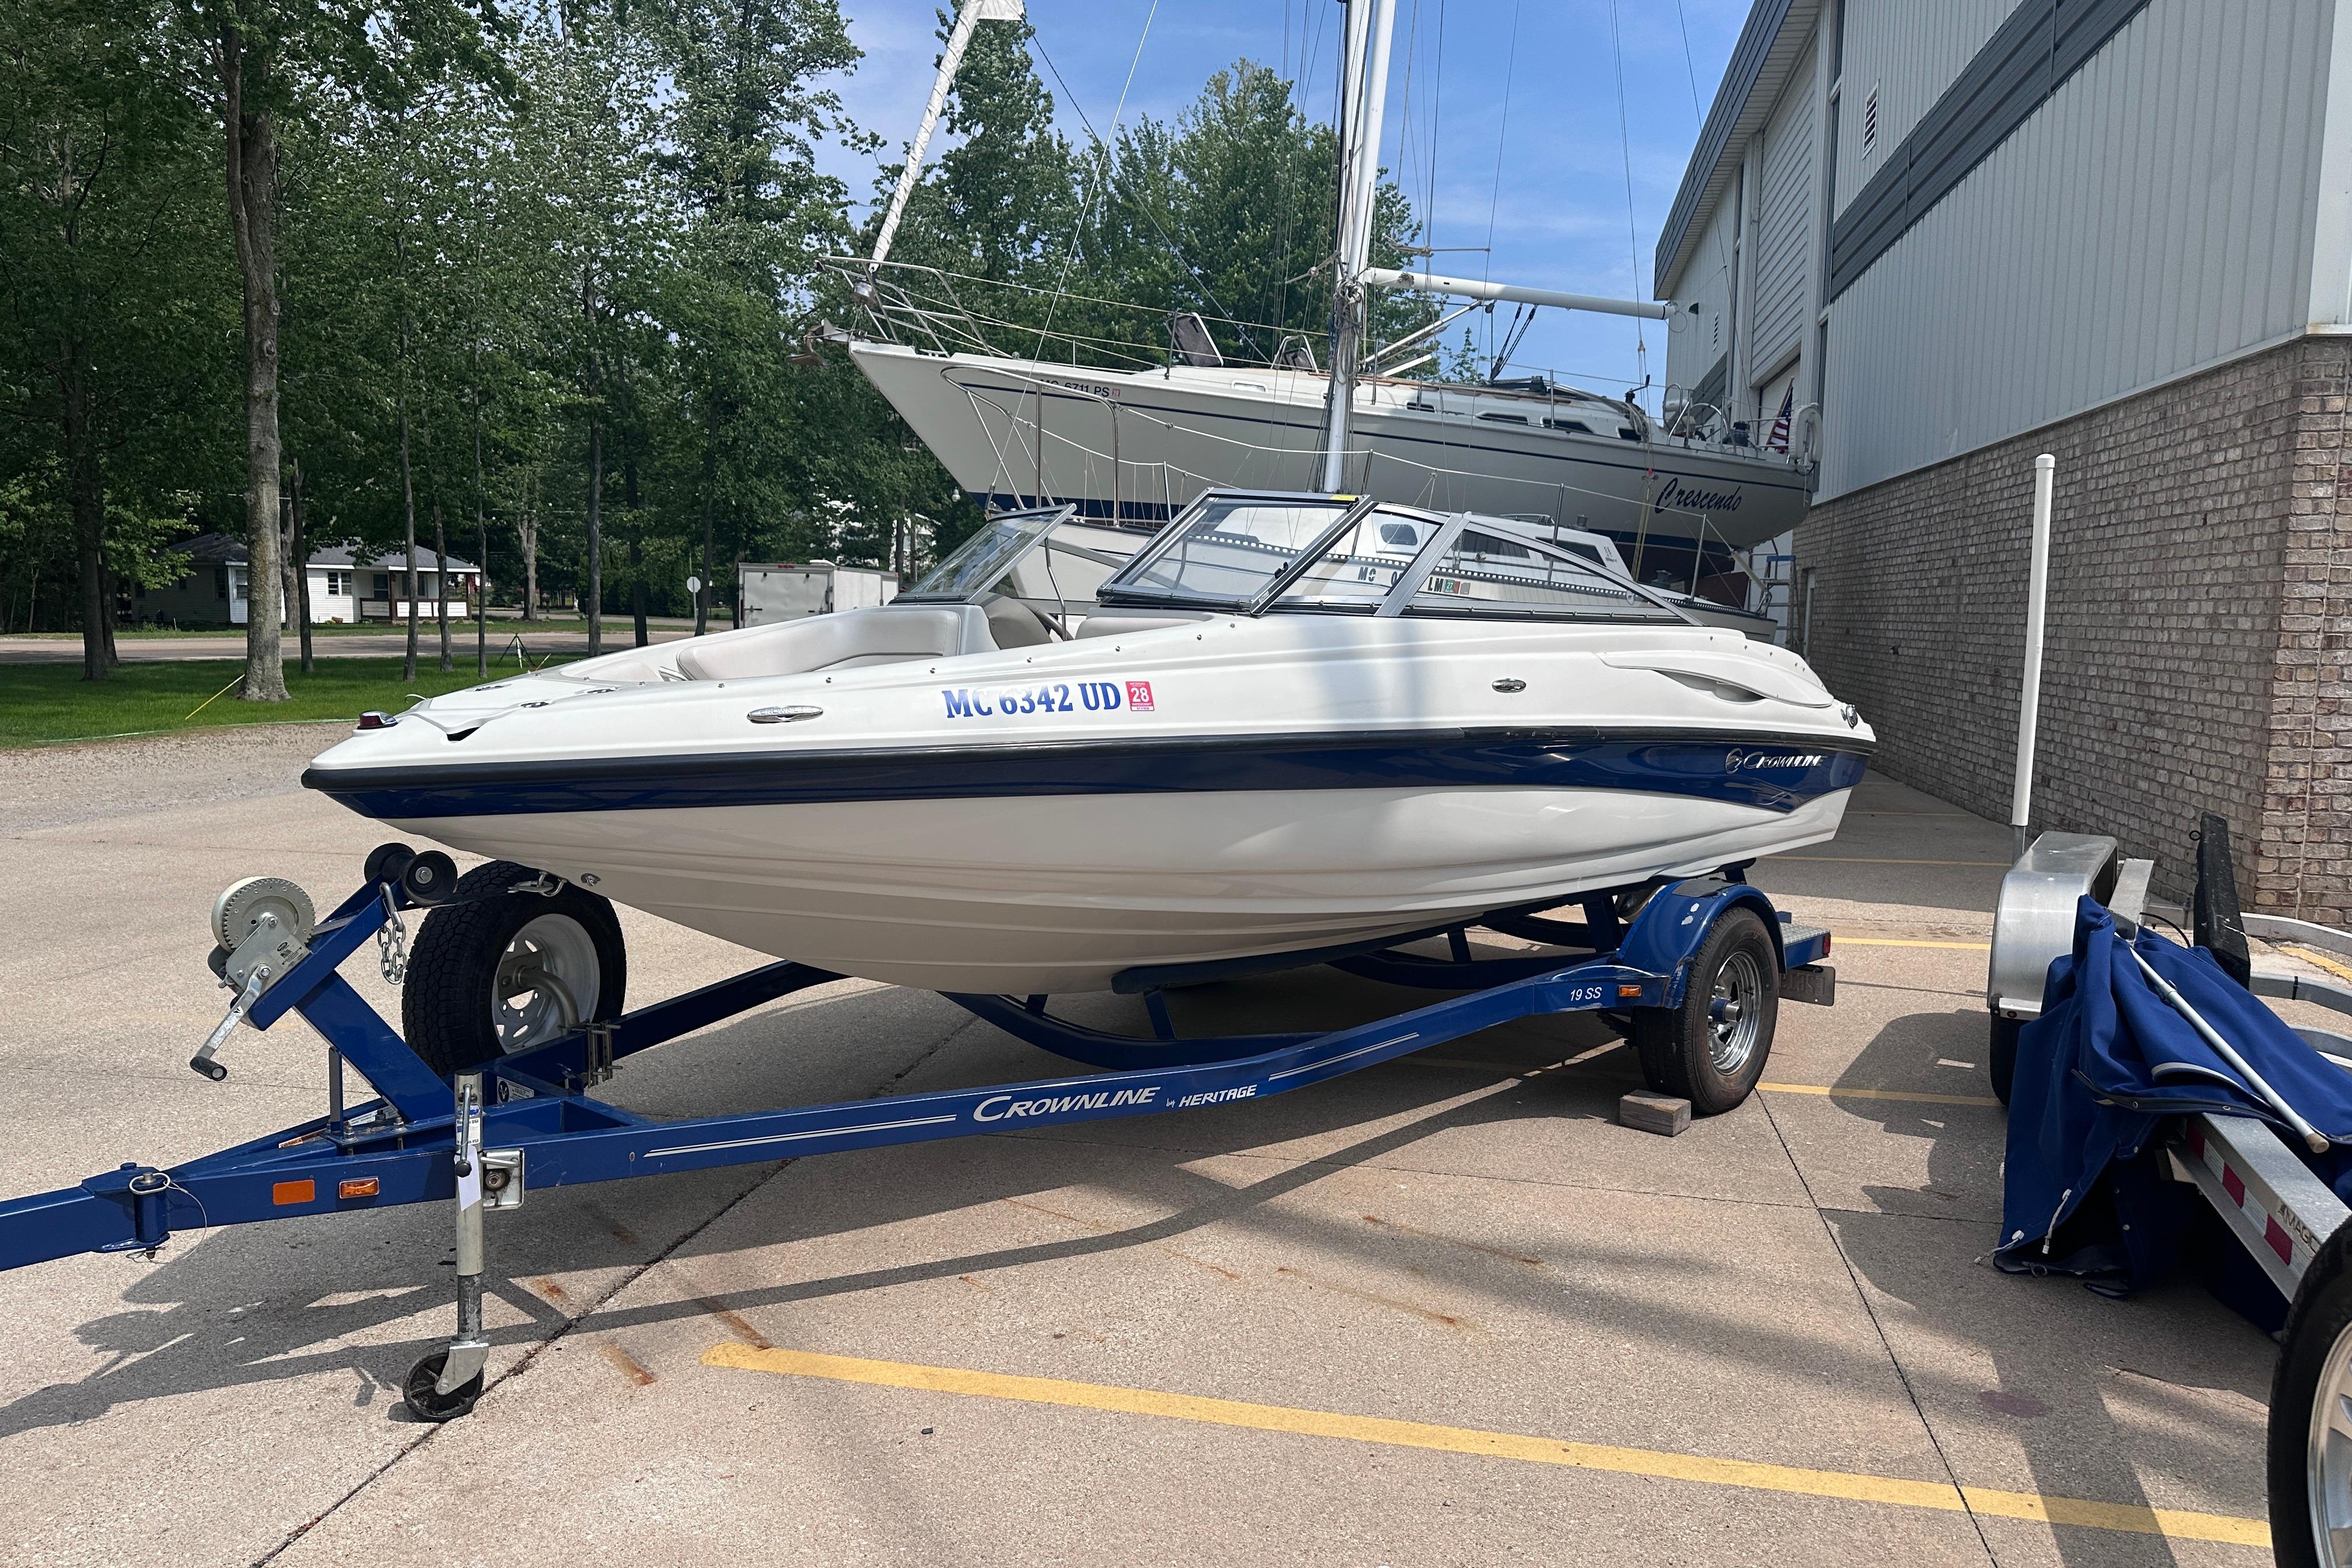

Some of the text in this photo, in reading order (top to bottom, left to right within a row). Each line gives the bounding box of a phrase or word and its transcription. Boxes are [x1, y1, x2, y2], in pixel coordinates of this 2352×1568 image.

[1094, 386, 1110, 397] PS
[1655, 477, 1742, 513] Crescendo
[1357, 567, 1376, 582] MC
[942, 682, 1121, 718] MC 6342 UD
[1130, 687, 1150, 702] 28
[1570, 986, 1602, 1002] 19 SS
[973, 1084, 1258, 1122] CROWNLINE by HERITAGE
